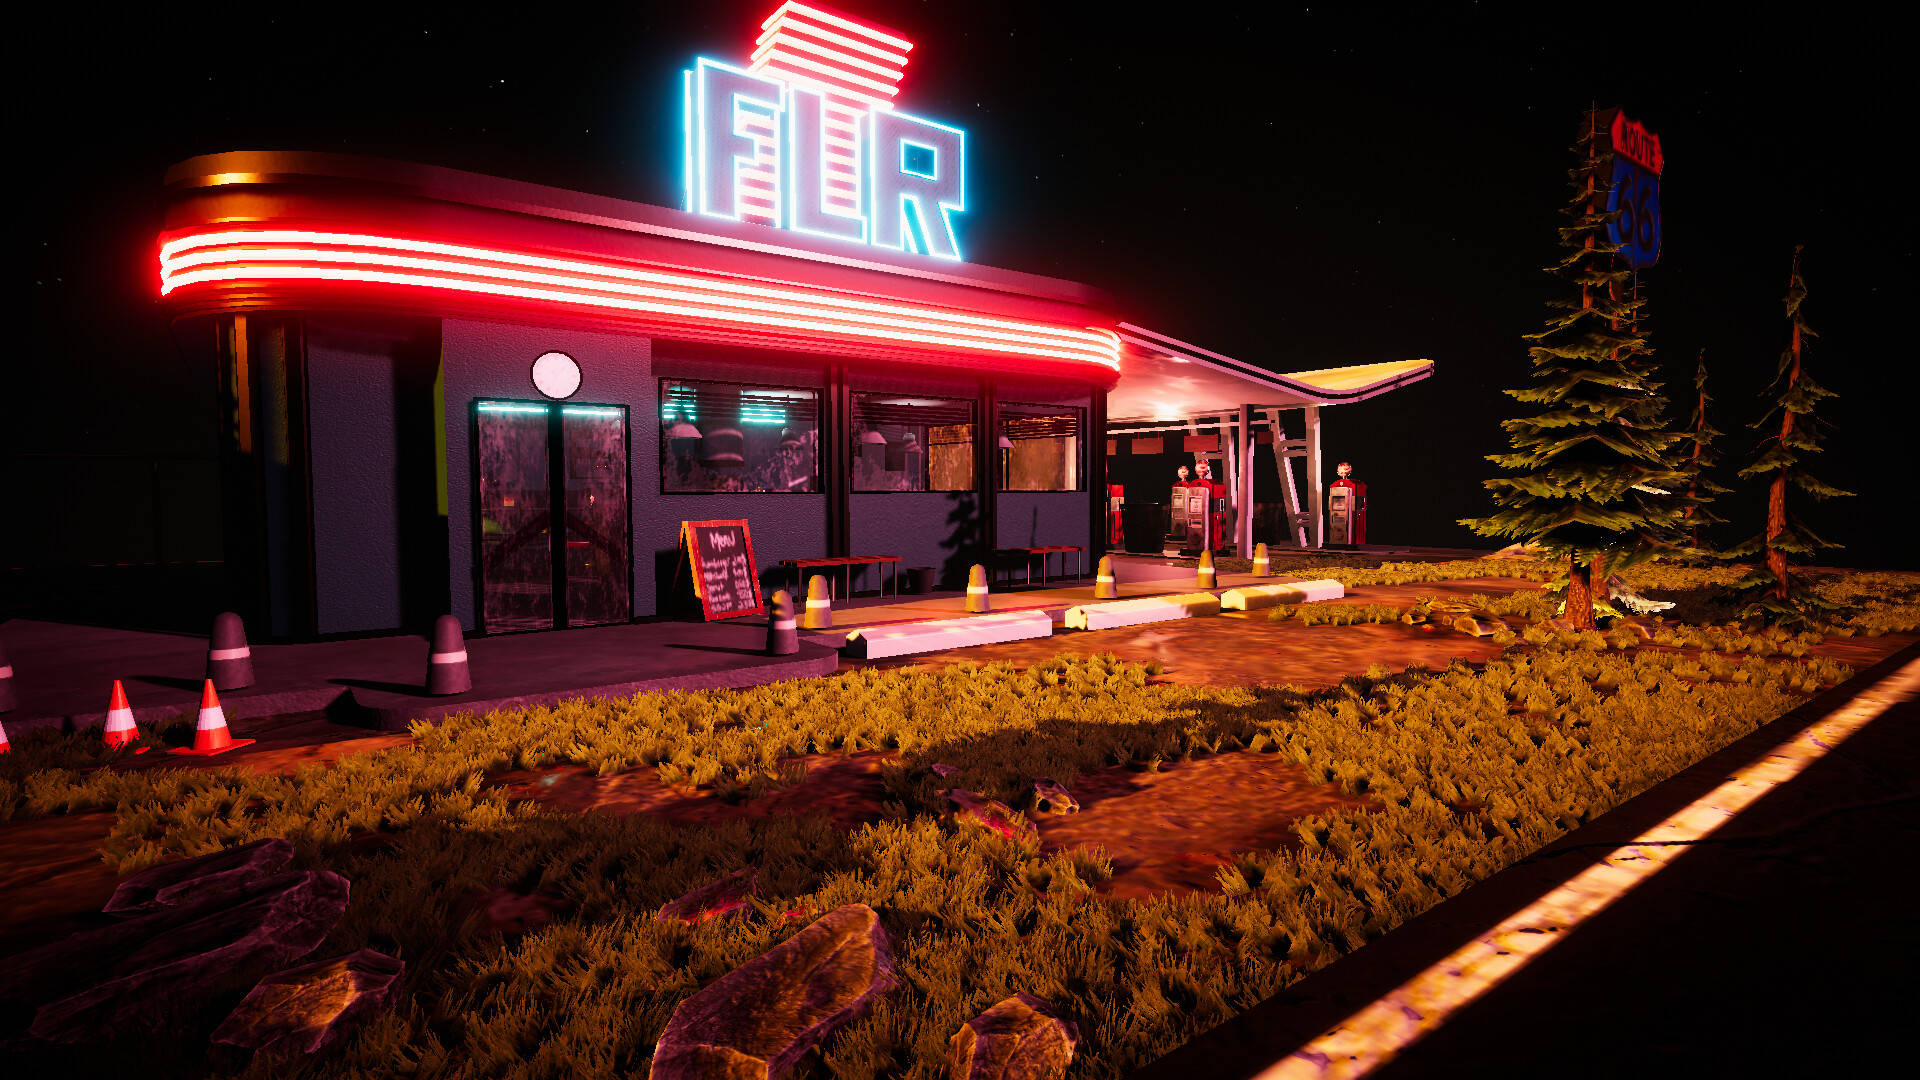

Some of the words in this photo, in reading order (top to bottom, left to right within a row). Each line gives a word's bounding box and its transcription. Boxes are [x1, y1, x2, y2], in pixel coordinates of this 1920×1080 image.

[691, 55, 965, 262] FLR
[1621, 120, 1656, 168] ROUTE
[1617, 173, 1655, 253] 66
